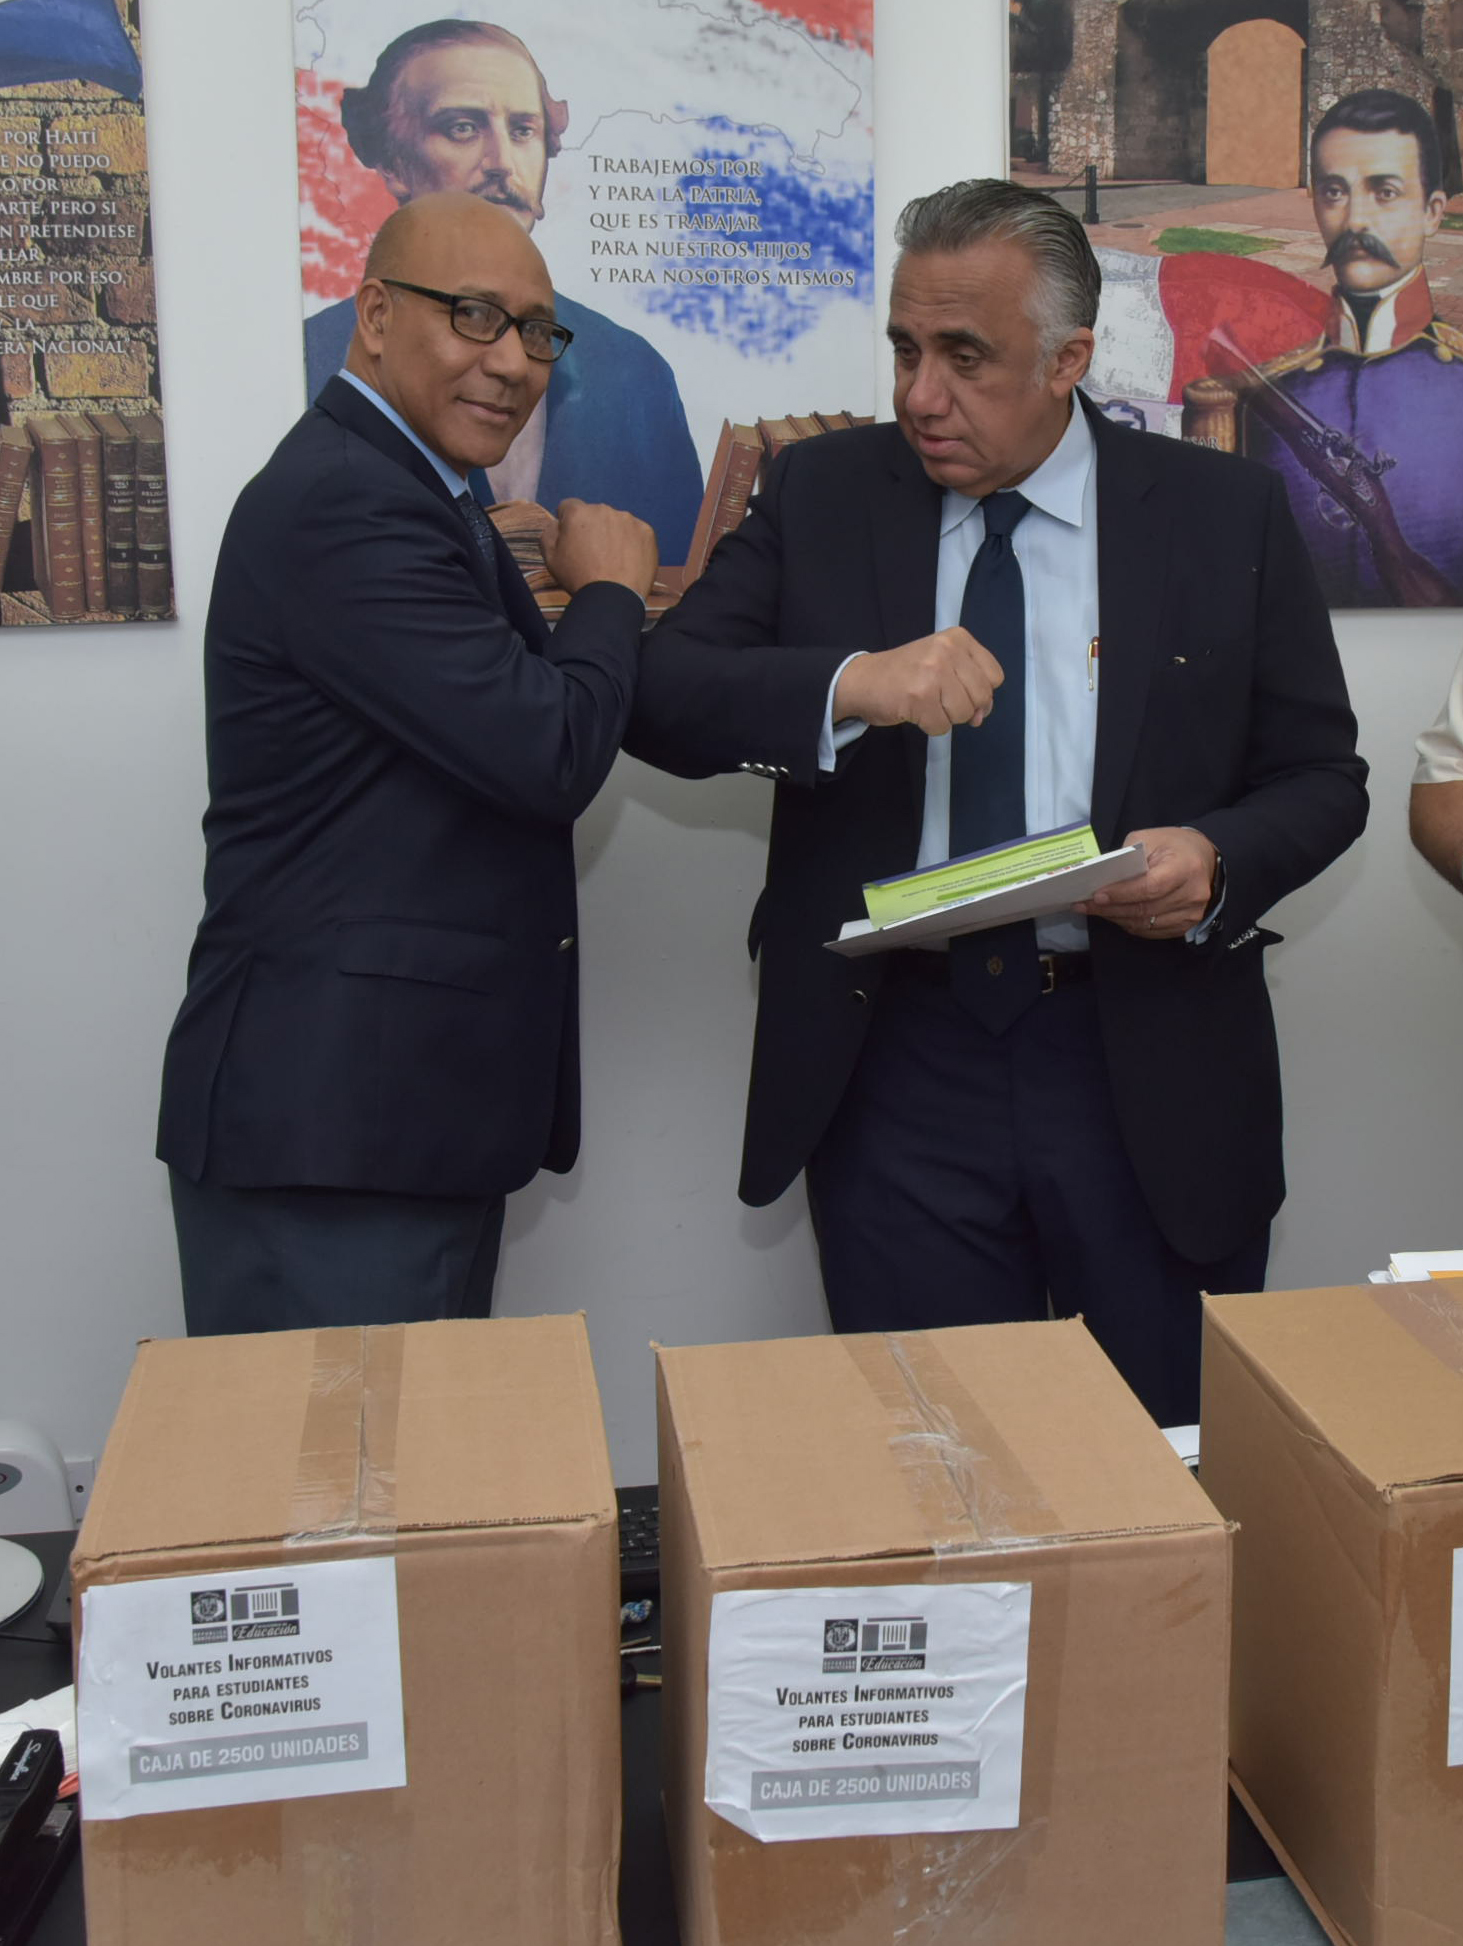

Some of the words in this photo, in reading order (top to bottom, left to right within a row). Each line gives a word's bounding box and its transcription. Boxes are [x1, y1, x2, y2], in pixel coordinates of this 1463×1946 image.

[4, 131, 39, 144] POR
[45, 127, 98, 144] HAITÍ
[15, 154, 43, 168] NO
[50, 155, 111, 169] PUEDO
[588, 155, 716, 177] TRABAJEMOS
[722, 160, 763, 176] POR
[23, 178, 59, 191] POR
[588, 185, 601, 200] Y
[607, 186, 655, 201] PARA
[662, 187, 684, 202] LA
[691, 187, 761, 204] PATRIA,
[51, 201, 96, 215] PERO
[101, 202, 117, 215] SI
[20, 224, 136, 239] PRETENDIESE
[590, 212, 631, 232] QUE
[638, 214, 658, 229] ES
[665, 214, 761, 233] TRABAJAR
[591, 241, 639, 256] PARA
[645, 241, 748, 258] NUESTROS
[754, 242, 812, 261] HIJOS
[50, 271, 85, 285] POR
[91, 272, 127, 286] ESO,
[590, 268, 602, 282] Y
[609, 268, 656, 283] PARA
[662, 270, 771, 286] NOSOTROS
[777, 271, 856, 287] MISMOS
[22, 294, 59, 310] QUE
[16, 317, 35, 331] LA
[146, 1658, 222, 1680] VOLANTES
[228, 1649, 334, 1672] INFORMATIVOS
[173, 1685, 211, 1701] PARA
[216, 1674, 310, 1697] ESTUDIANTES
[776, 1687, 848, 1706] VOLANTES
[854, 1684, 954, 1703] INFORMATIVOS
[168, 1708, 215, 1726] SOBRE
[220, 1697, 322, 1720] CORONAVIRUS
[799, 1714, 834, 1729] PARA
[840, 1709, 930, 1727] ESTUDIANTES
[792, 1739, 836, 1753] SOBRE
[842, 1732, 939, 1750] CORONAVIRUS
[139, 1751, 184, 1774] CAJA
[189, 1749, 213, 1768] DE
[218, 1744, 264, 1766] 2500
[270, 1733, 360, 1760] UNIDADES
[760, 1780, 803, 1799] CAJA
[808, 1778, 830, 1797] DE
[836, 1776, 881, 1795] 2500
[886, 1771, 972, 1792] UNIDADES
